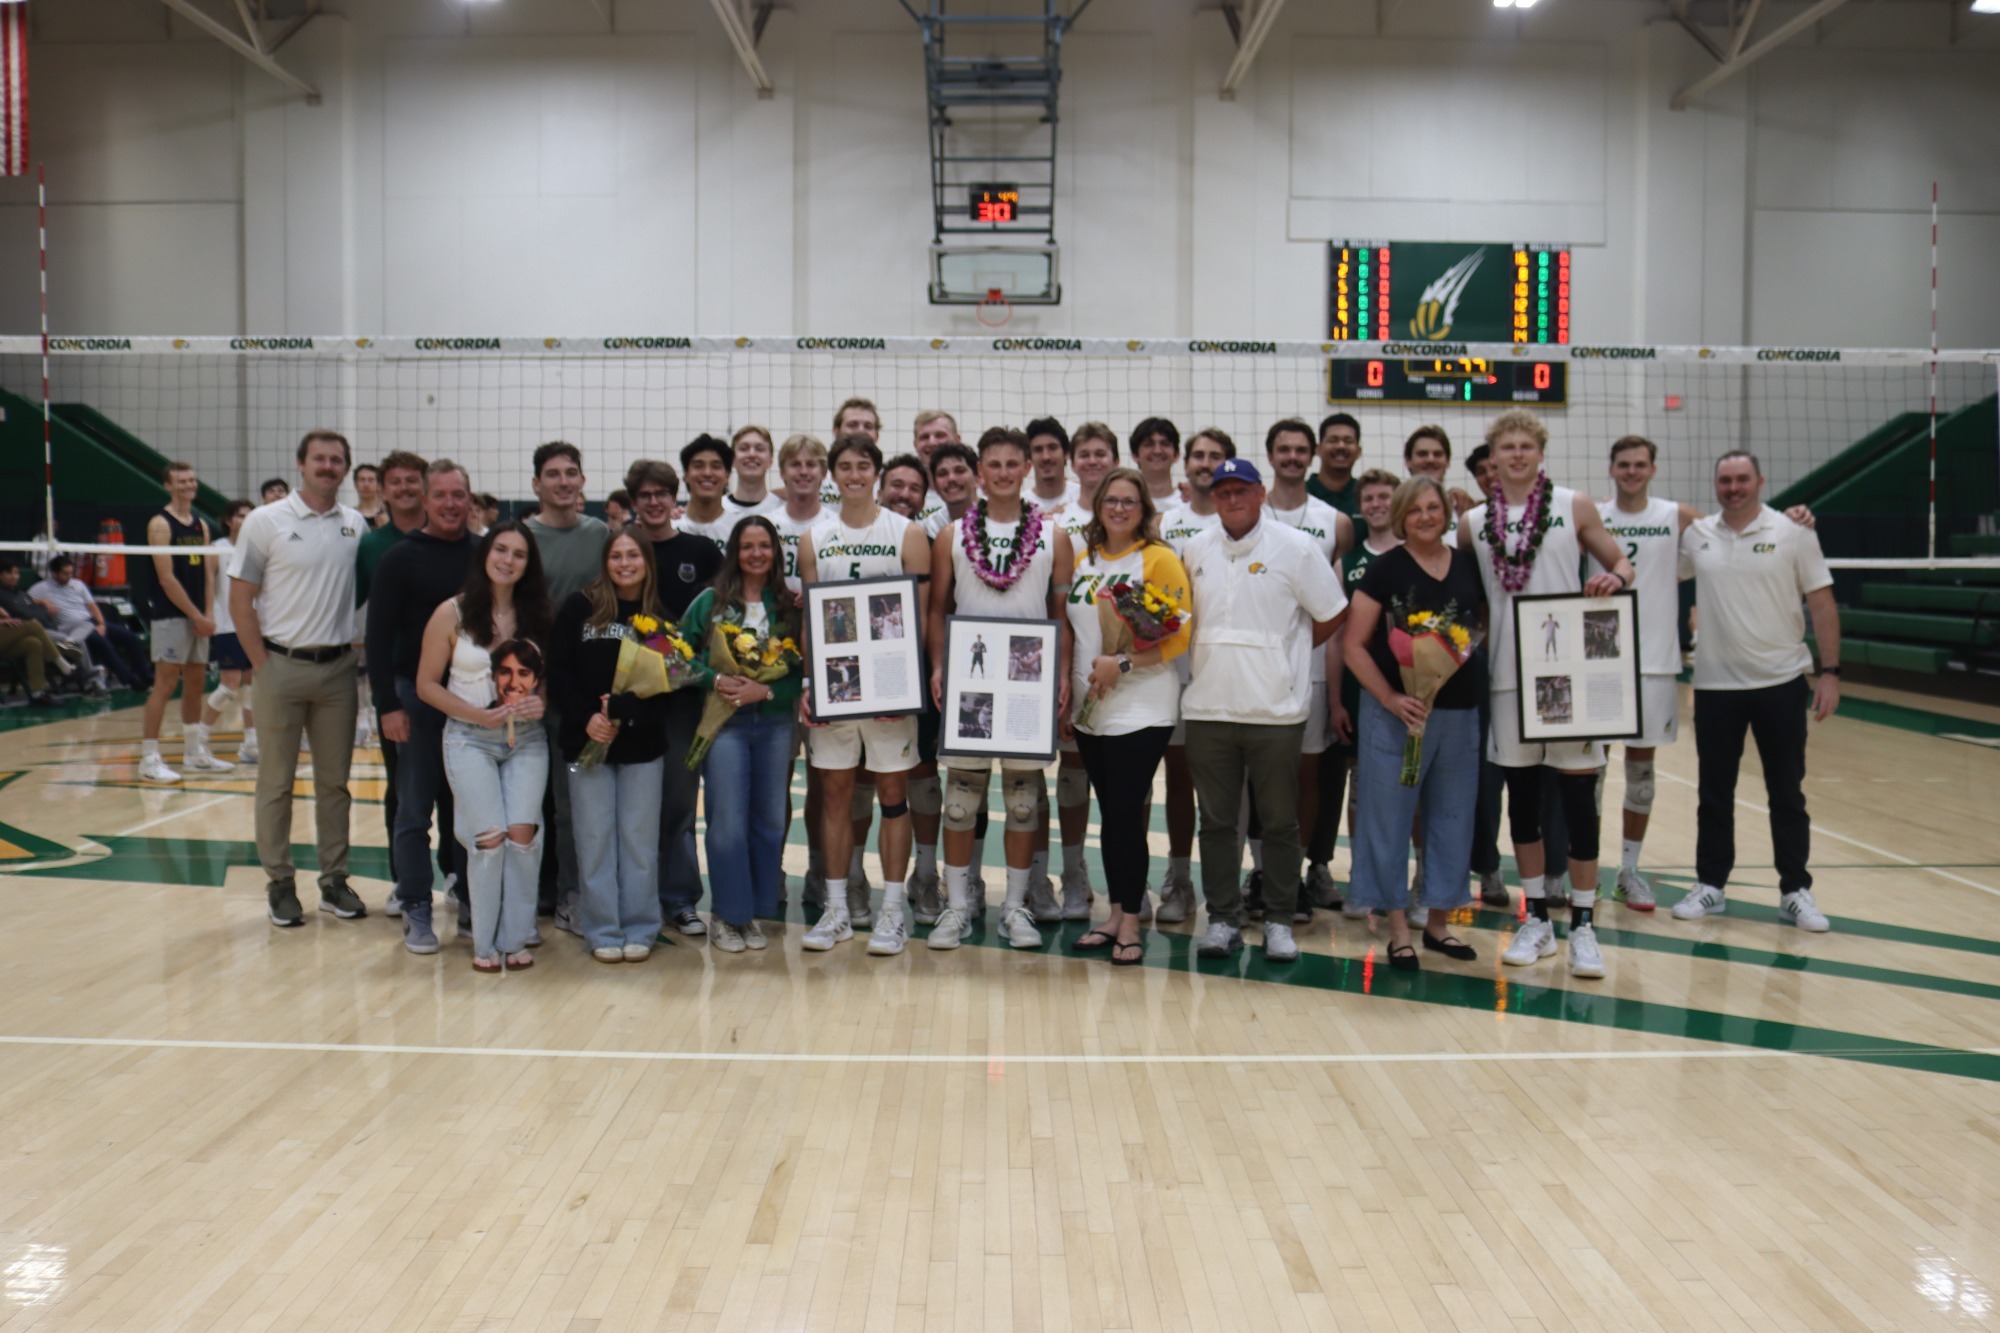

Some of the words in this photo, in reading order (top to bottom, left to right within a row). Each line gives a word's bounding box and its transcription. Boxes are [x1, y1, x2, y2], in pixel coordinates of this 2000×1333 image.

[977, 202, 1011, 222] 30
[49, 338, 131, 351] CONCORDIA
[230, 338, 314, 350] CONCORDIA
[415, 338, 501, 350] CONCORDIA
[603, 337, 692, 349] CONCORDIA
[796, 337, 886, 350] CONCORDIA
[992, 338, 1082, 351] CONCORDIA
[1187, 340, 1277, 354] CONCORDIA
[1381, 343, 1468, 356] CONCORDIA
[1570, 346, 1656, 359] CONCORDIA
[1756, 349, 1841, 362] CONCORDIA
[1367, 361, 1383, 387] 0
[1534, 363, 1551, 389] 0
[818, 544, 897, 560] CONCORDIA
